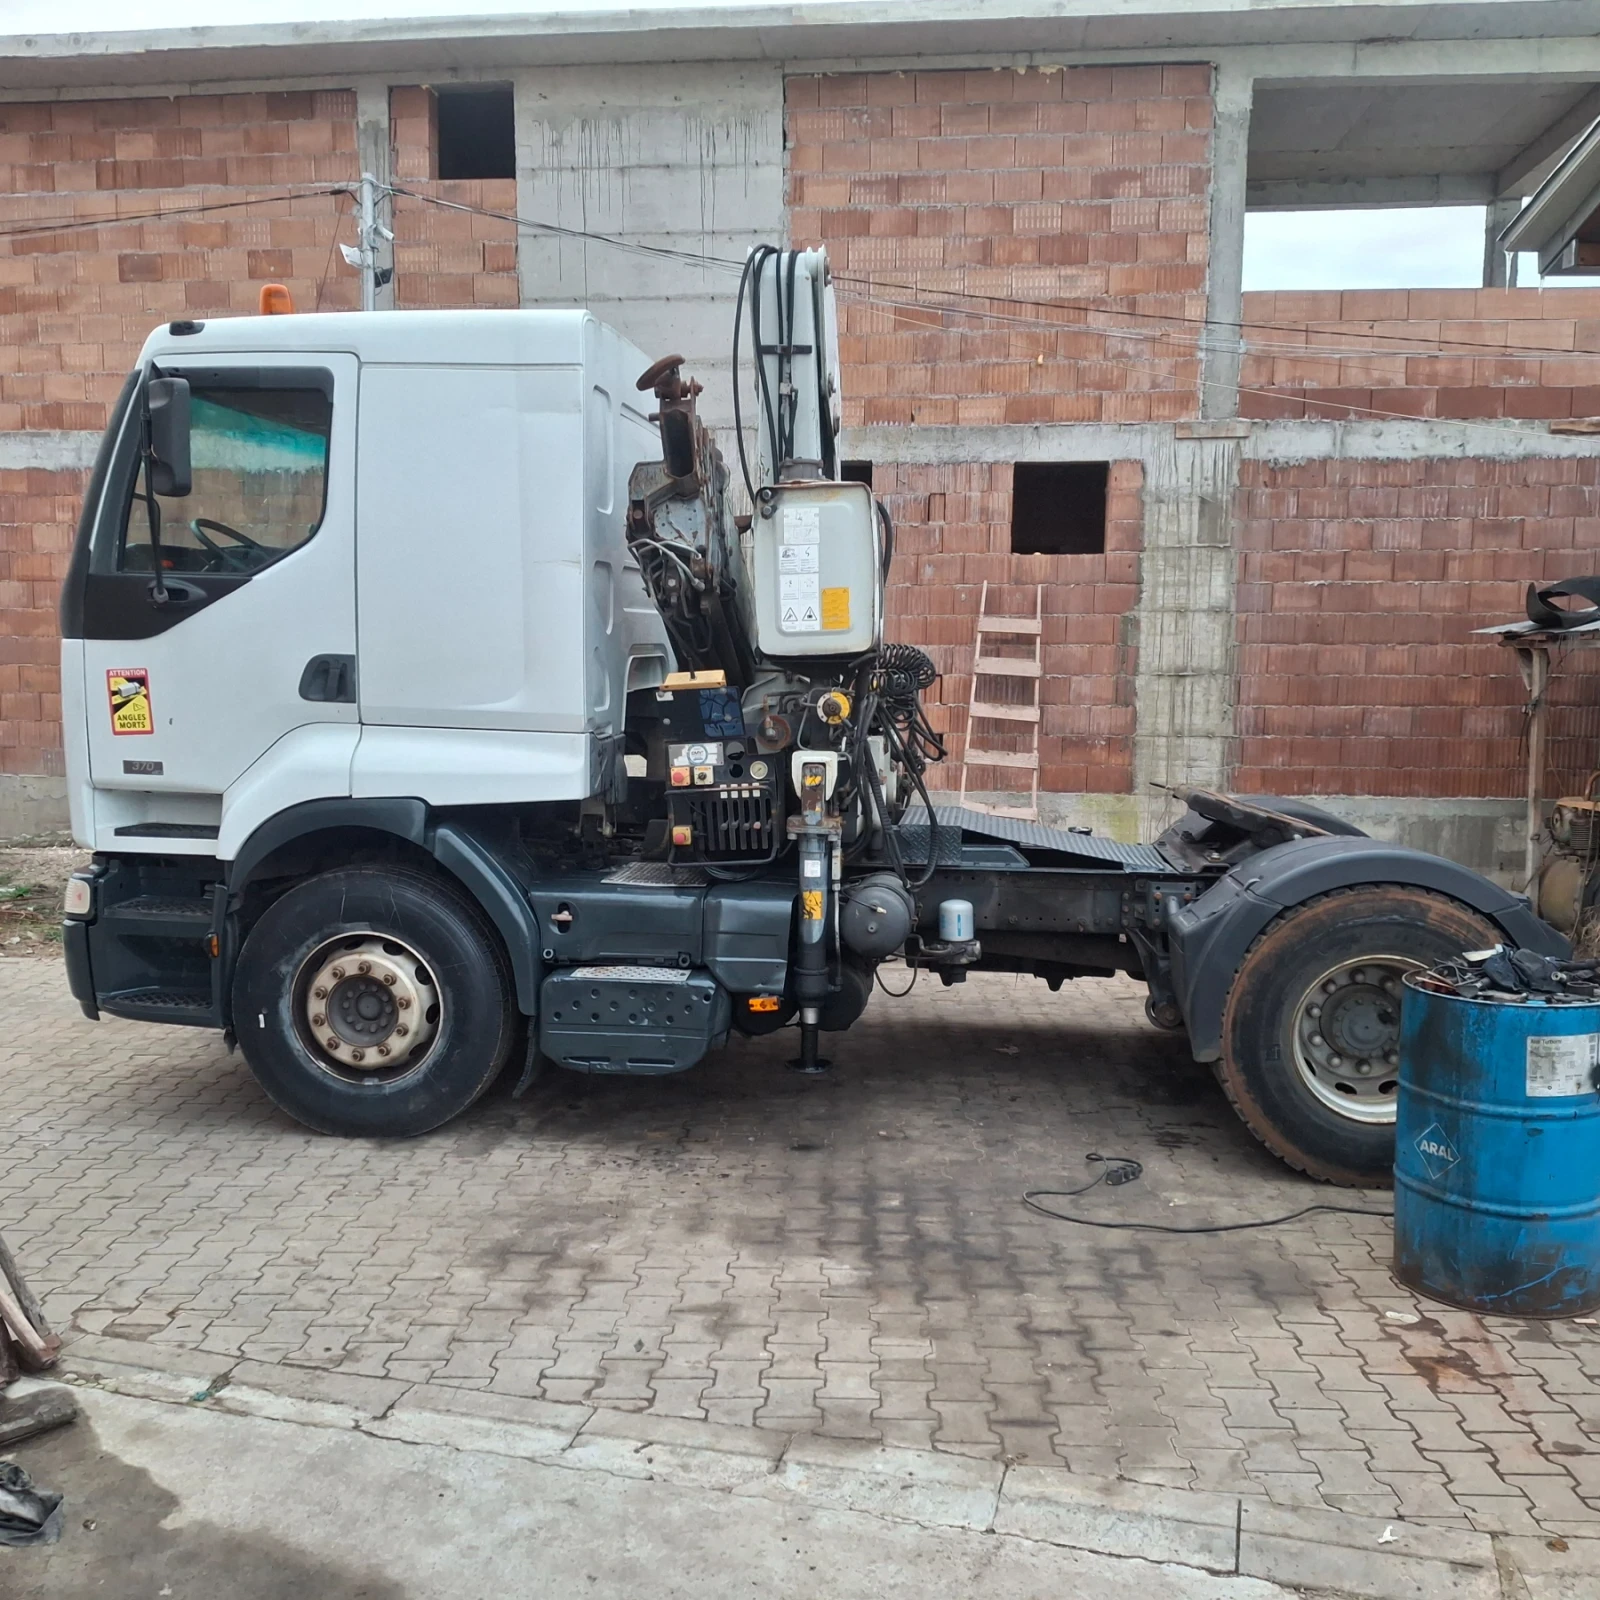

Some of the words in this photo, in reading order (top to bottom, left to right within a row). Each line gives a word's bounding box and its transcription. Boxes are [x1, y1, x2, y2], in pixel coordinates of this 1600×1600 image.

[117, 713, 146, 721] ANGLES
[119, 721, 146, 729] MORTS
[132, 762, 154, 771] 370
[1419, 1139, 1454, 1162] ARAL
